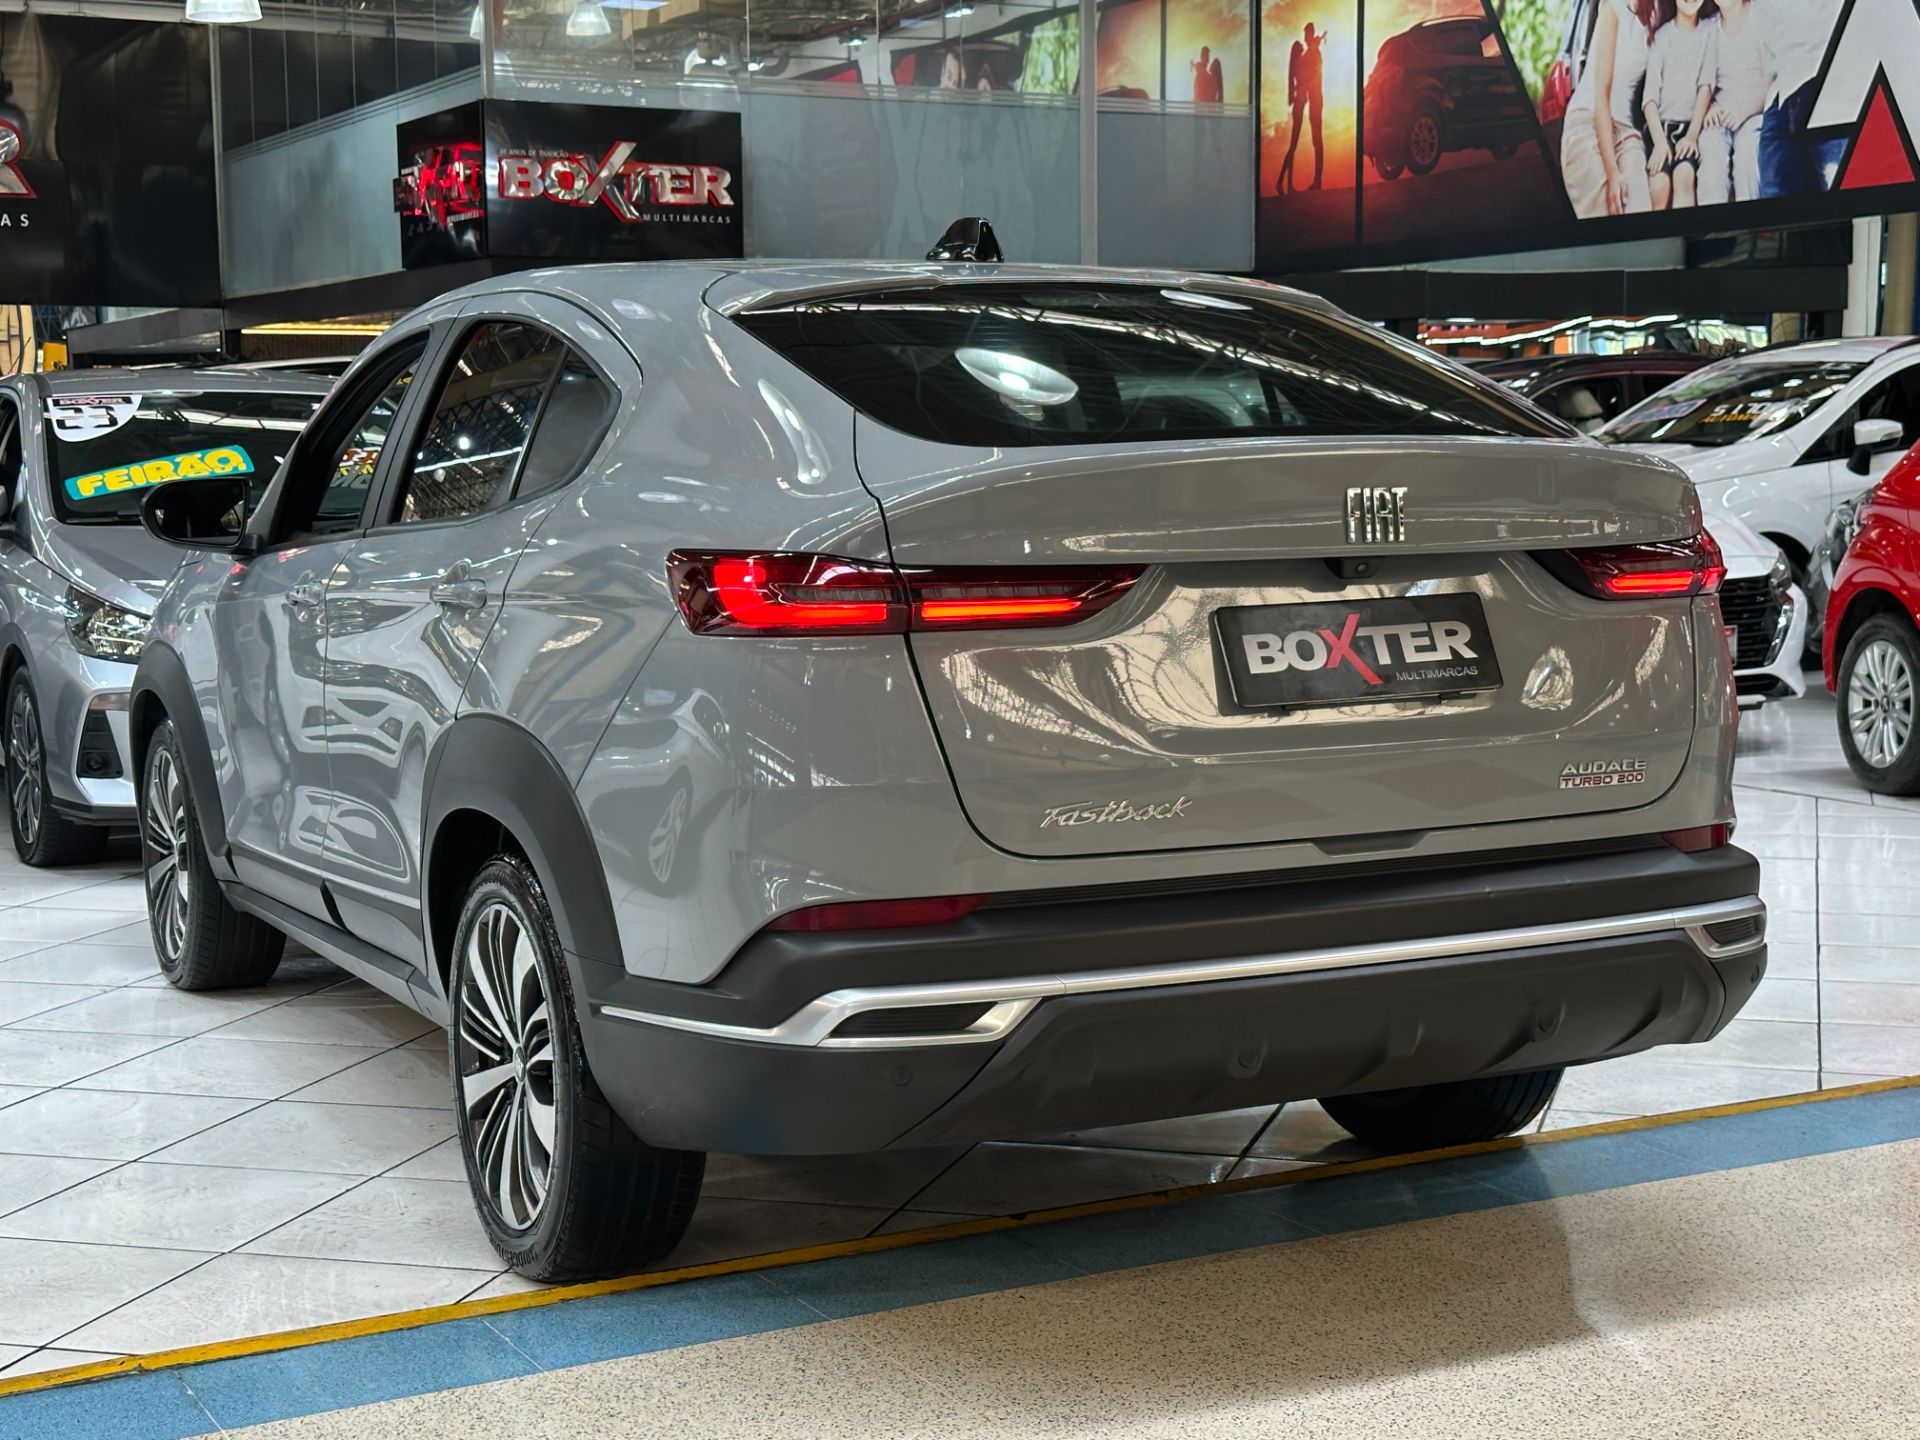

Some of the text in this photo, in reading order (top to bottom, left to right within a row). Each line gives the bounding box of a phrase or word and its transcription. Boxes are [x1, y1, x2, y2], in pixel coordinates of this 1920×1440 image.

[498, 140, 734, 223] BOXTER
[643, 213, 732, 224] MULTIMARCAS
[77, 448, 244, 497] FEIRÃO
[1346, 486, 1408, 543] FIAT
[1241, 611, 1479, 685] BOXTER
[1396, 665, 1479, 681] MULTIMARCAS
[1561, 758, 1647, 775] AUDACE
[1561, 772, 1644, 787] TURBO 200
[1040, 795, 1193, 828] Fastback
